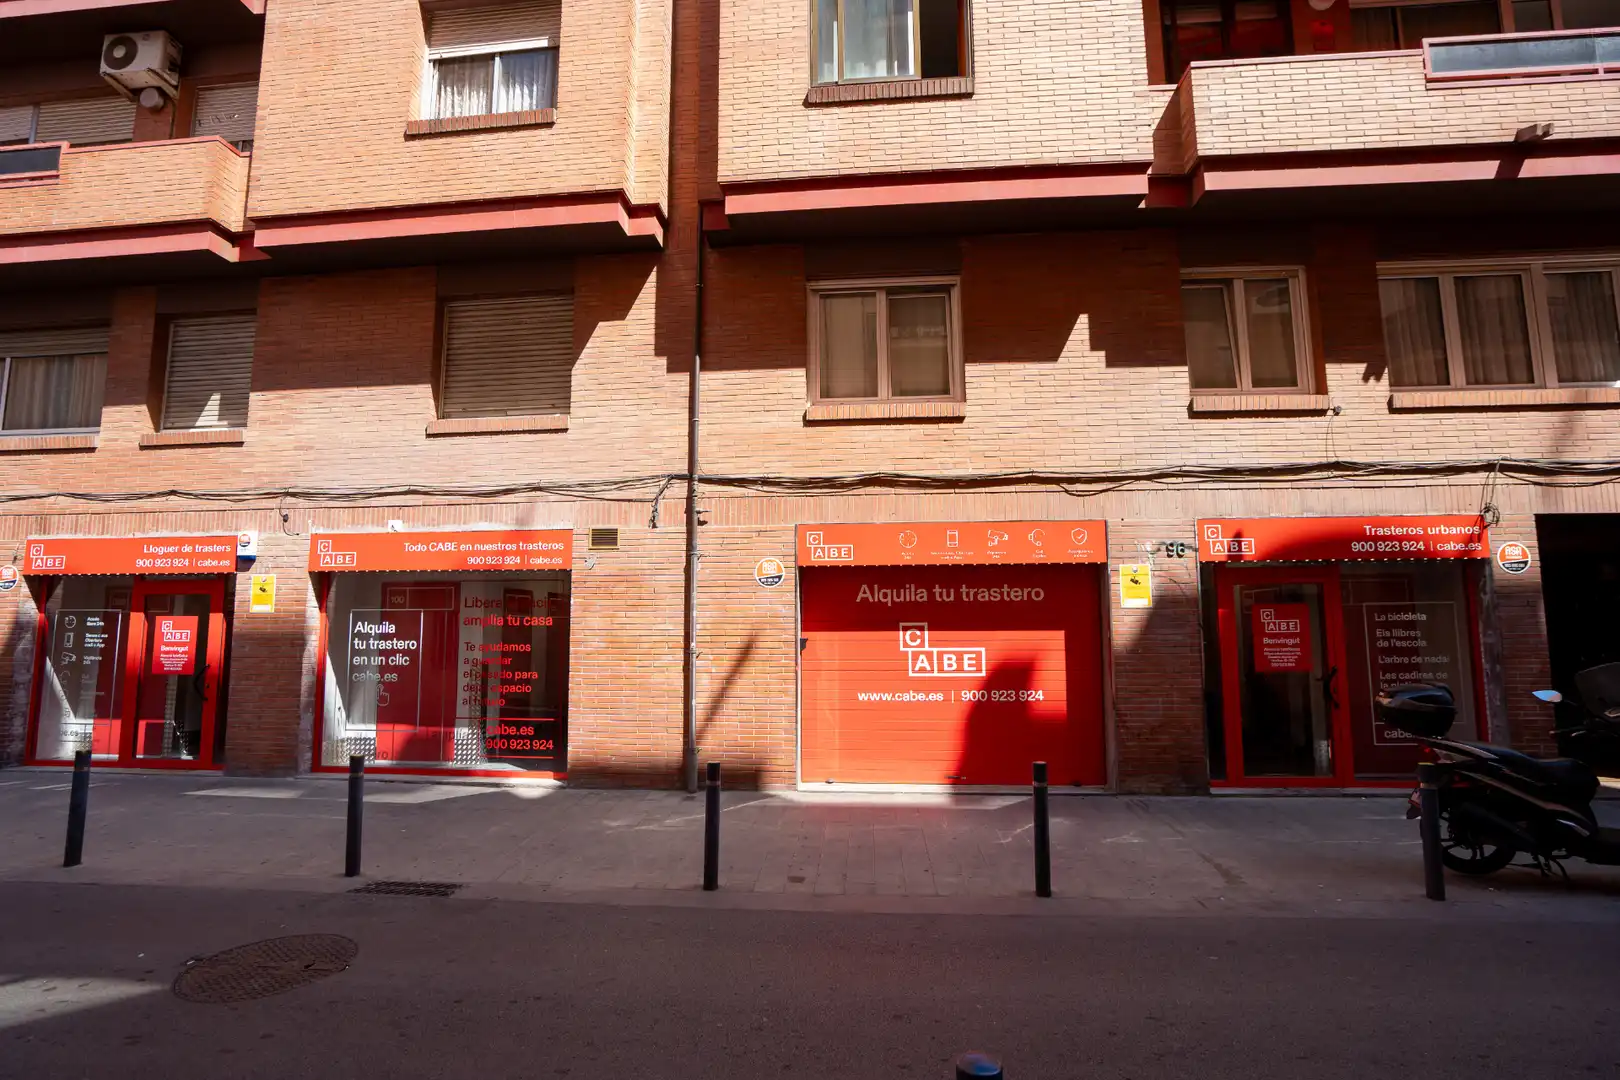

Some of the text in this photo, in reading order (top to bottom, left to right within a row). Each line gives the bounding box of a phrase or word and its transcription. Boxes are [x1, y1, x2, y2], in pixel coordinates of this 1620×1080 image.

[1363, 524, 1482, 536] Trasteros urbanos
[143, 544, 232, 555] Lloguer de trasters
[404, 542, 426, 552] Todo
[428, 542, 458, 552] CABE
[474, 542, 517, 551] nuestros
[518, 541, 564, 550] trasteros
[1351, 541, 1374, 552] 900
[1376, 541, 1400, 552] 923
[1402, 541, 1426, 552] 924
[1436, 540, 1482, 552] cabe.es
[136, 558, 154, 568] 900
[154, 558, 172, 567] 923
[172, 558, 189, 567] 924
[198, 558, 230, 567] cabe.es
[467, 556, 484, 564] 900
[486, 556, 502, 564] 923
[504, 556, 521, 564] 924
[530, 555, 562, 564] cabe.es
[856, 584, 1044, 606] Alquila tu trastero
[506, 614, 520, 626] tu
[522, 616, 554, 626] casa
[1374, 612, 1428, 621] La bicicleta
[354, 621, 396, 636] Alquila
[1376, 628, 1422, 638] Els llibres
[354, 637, 418, 650] tu trastero
[1263, 636, 1300, 646] Benvingut
[1376, 639, 1428, 648] de l'escola
[464, 642, 532, 653] Te ayudamos
[352, 653, 410, 666] en un clic
[1378, 655, 1410, 664] L'arbre
[1410, 656, 1422, 664] de
[352, 670, 398, 682] cabe.es
[514, 671, 538, 682] para
[1379, 671, 1448, 680] Les cadires de
[857, 690, 944, 702] www.cabe.es
[960, 690, 988, 702] 900
[990, 690, 1016, 702] 923
[1018, 690, 1044, 702] 924
[486, 723, 535, 736] cabe.es
[1384, 728, 1416, 738] cabe.
[486, 738, 554, 750] 900 923 924
